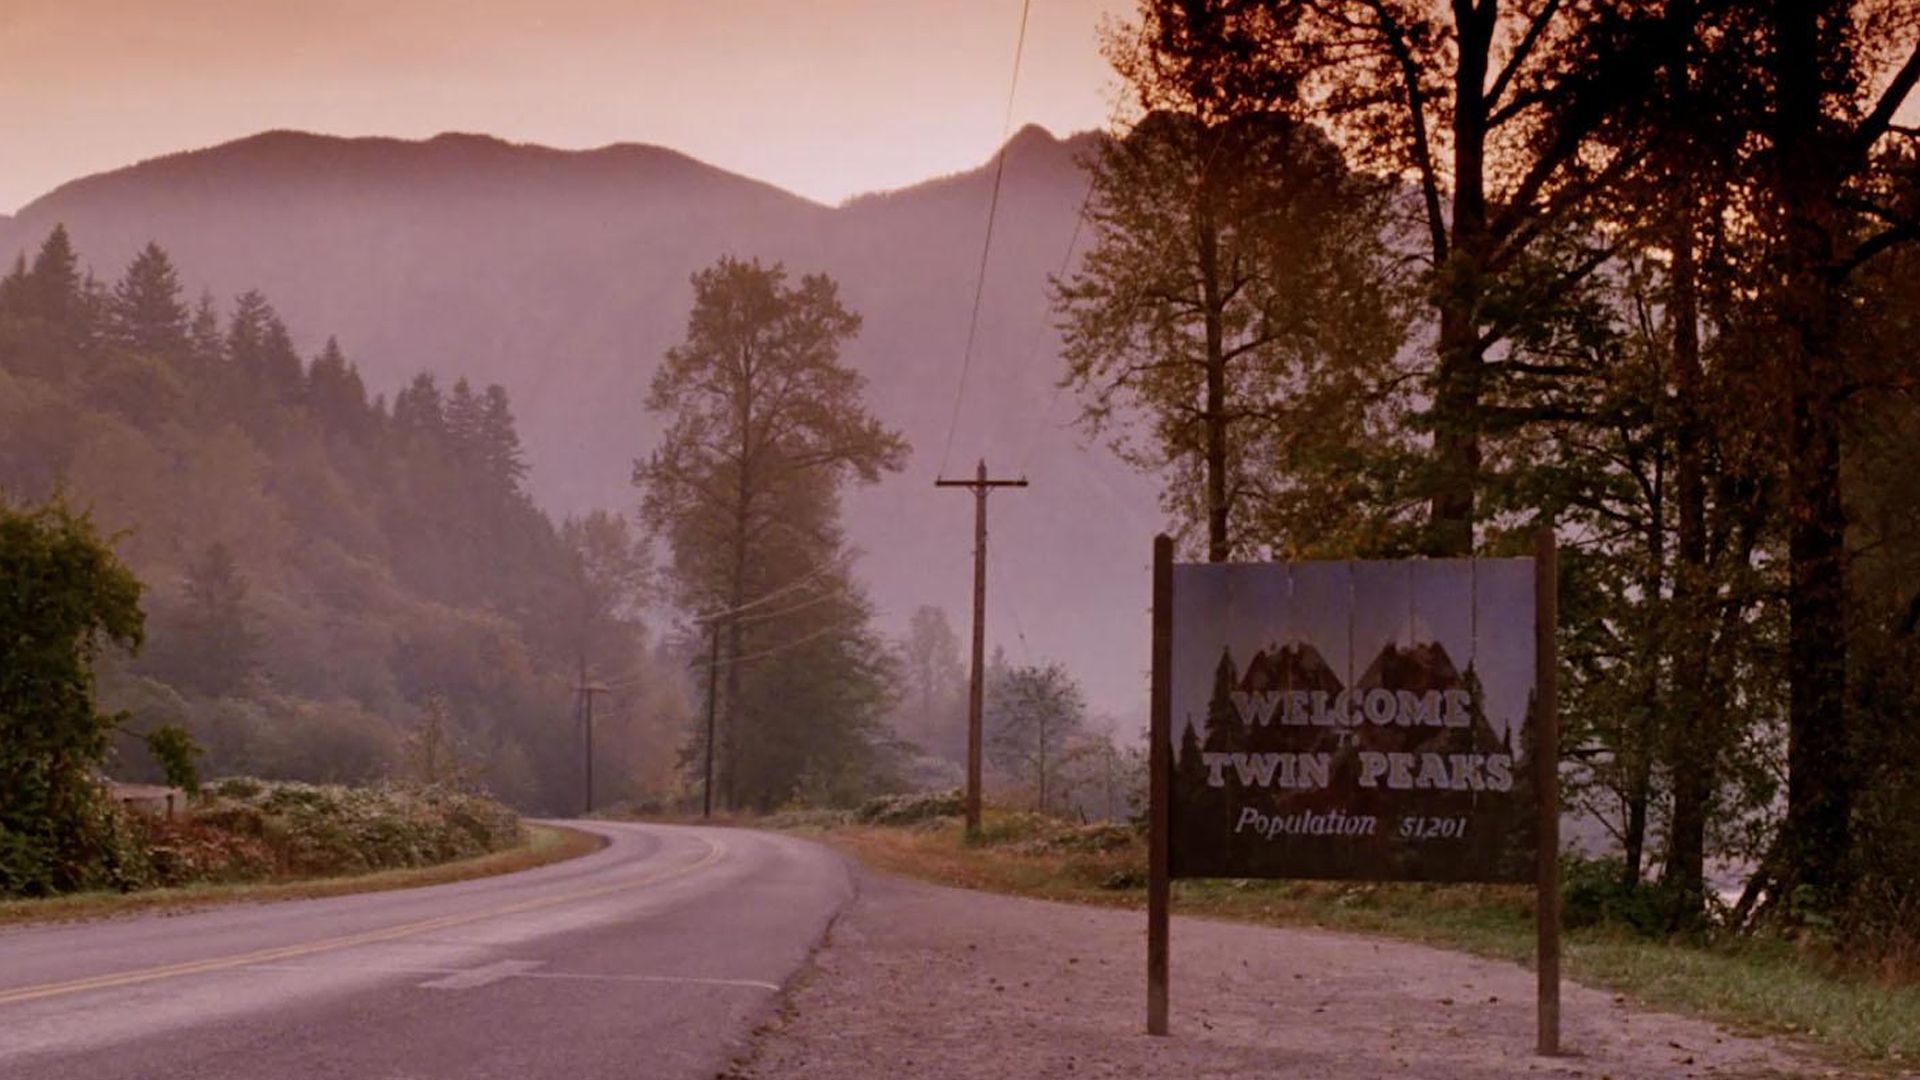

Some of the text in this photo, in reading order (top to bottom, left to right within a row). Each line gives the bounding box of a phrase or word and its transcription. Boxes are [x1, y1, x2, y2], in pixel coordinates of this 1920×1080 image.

[1231, 688, 1472, 727] WELCOME
[1202, 751, 1514, 792] TWIN PEAKS
[1235, 807, 1467, 840] Population 51,201
